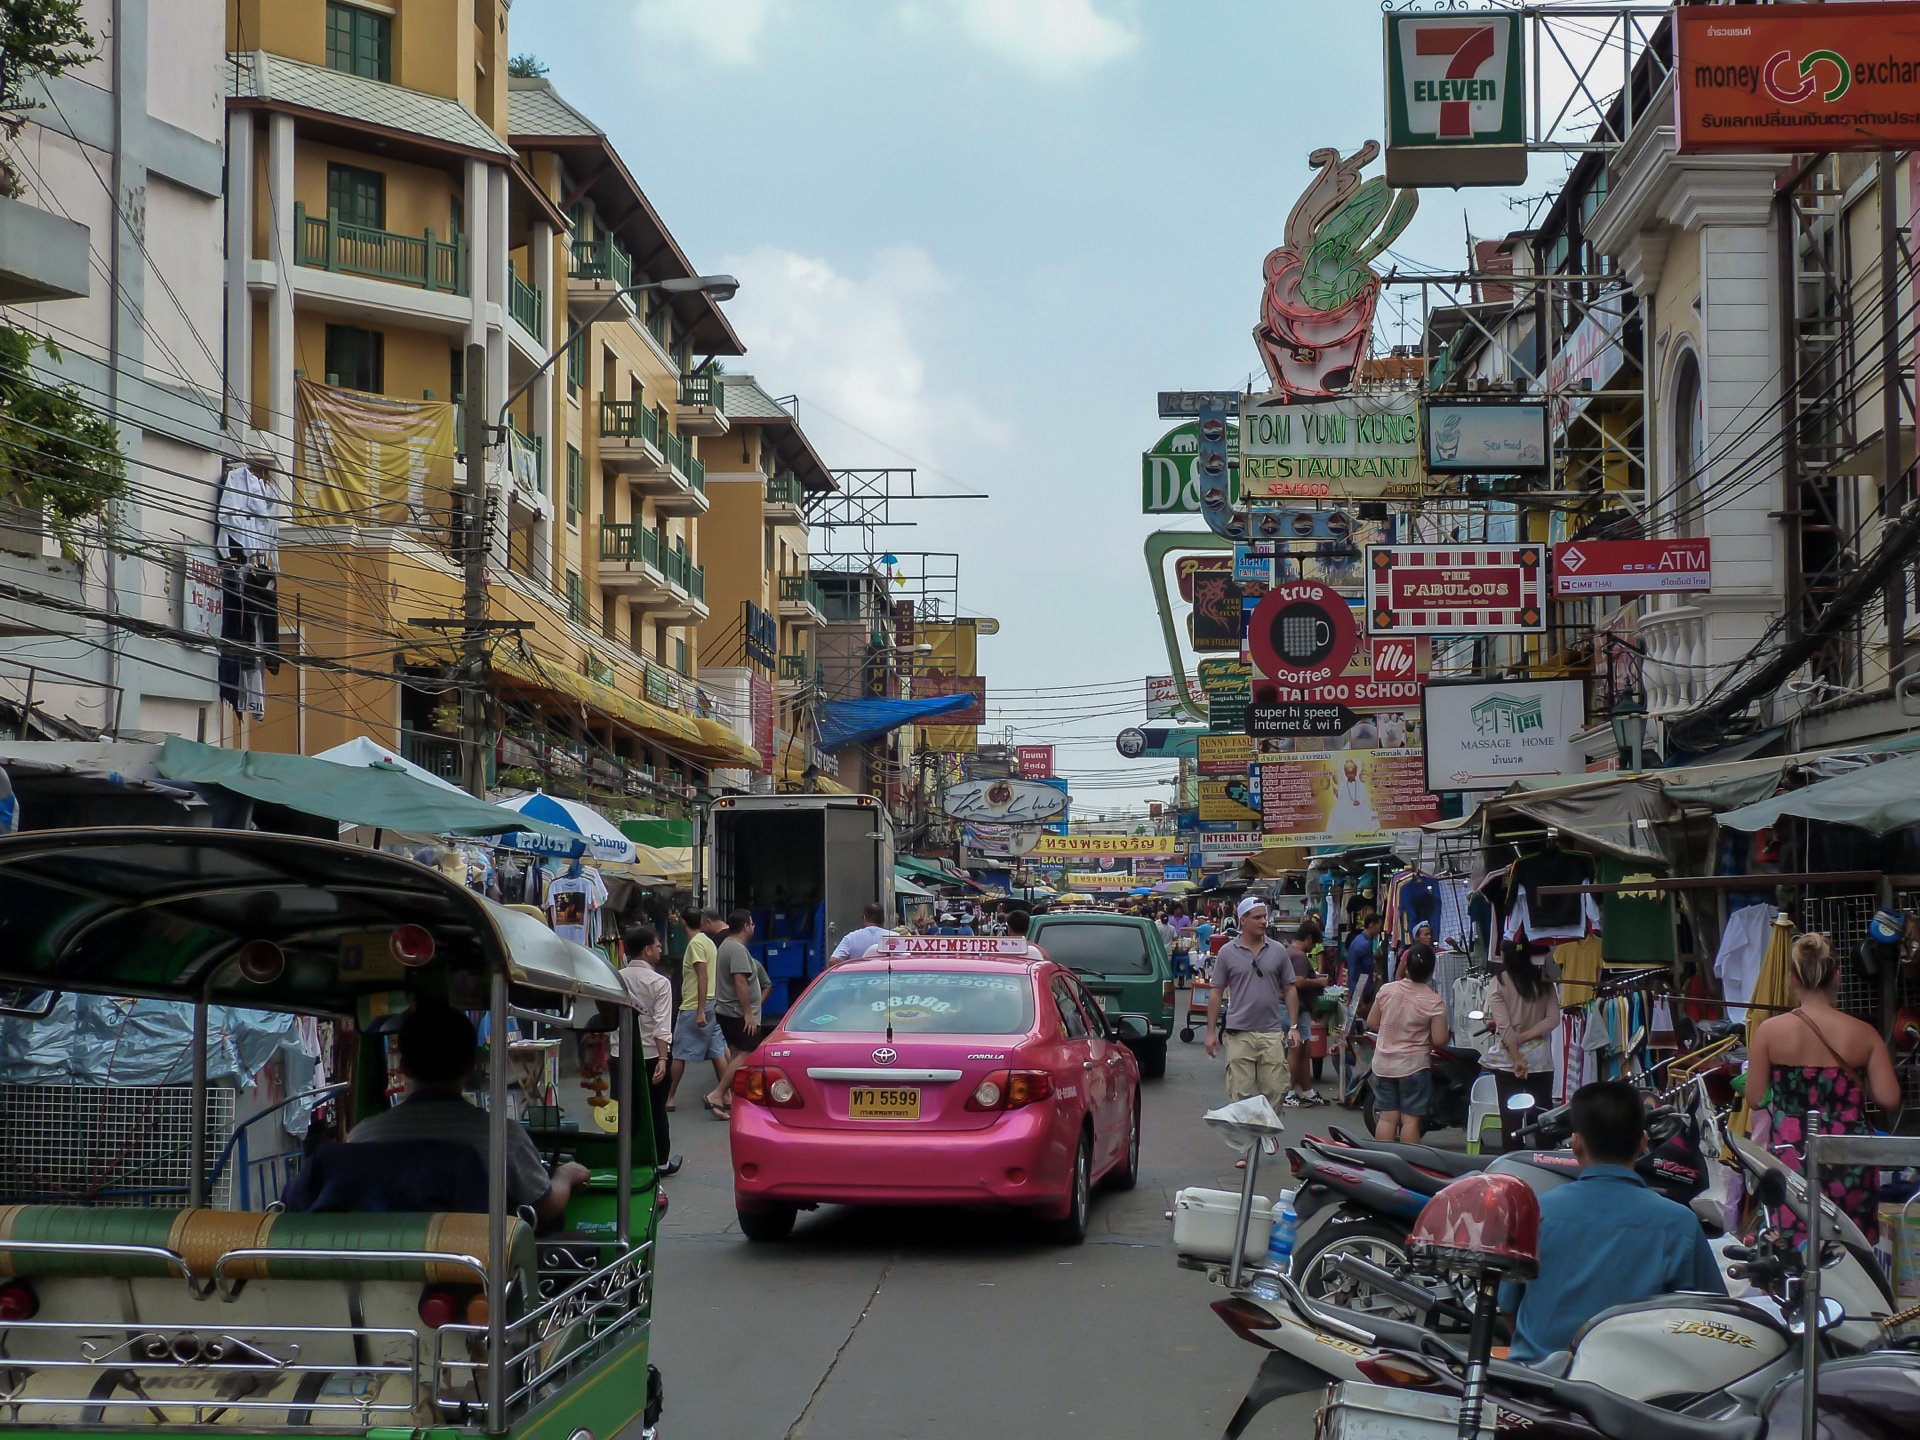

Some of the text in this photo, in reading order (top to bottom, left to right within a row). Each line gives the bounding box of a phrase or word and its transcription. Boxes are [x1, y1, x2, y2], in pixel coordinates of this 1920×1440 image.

[1416, 26, 1495, 136] 7
[1695, 65, 1759, 94] money
[1245, 413, 1416, 444] TOM YUM KUNG
[1483, 439, 1521, 451] Sea Food
[1245, 457, 1415, 478] RESTAURANT
[1268, 482, 1330, 497] SEA FOOD
[1658, 551, 1705, 570] ATM
[1441, 571, 1470, 580] THE
[1403, 583, 1508, 597] FABULOUS
[1571, 581, 1592, 589] CIMB
[1280, 587, 1324, 600] true
[1376, 644, 1413, 678] illy
[1278, 667, 1331, 684] coffee
[1254, 708, 1287, 719] super
[1289, 706, 1300, 717] hi
[1304, 706, 1339, 719] speed
[1254, 719, 1341, 730] internet & wi fi
[1200, 738, 1229, 748] SUNNY
[1461, 737, 1554, 749] MASSAGE HOME
[1371, 749, 1401, 757] Samnak
[1492, 754, 1523, 764] บ้านนวด
[950, 789, 1060, 815] The Club
[1046, 837, 1154, 850] ทรงพระเจริญ
[1203, 833, 1249, 843] INTERNET
[1041, 856, 1064, 864] BAG
[904, 939, 1000, 952] TAXI-METER
[880, 1090, 917, 1106] 5599
[1701, 1320, 1733, 1331] TIGER
[1671, 1320, 1756, 1349] BOXER
[1315, 1333, 1365, 1356] 200
